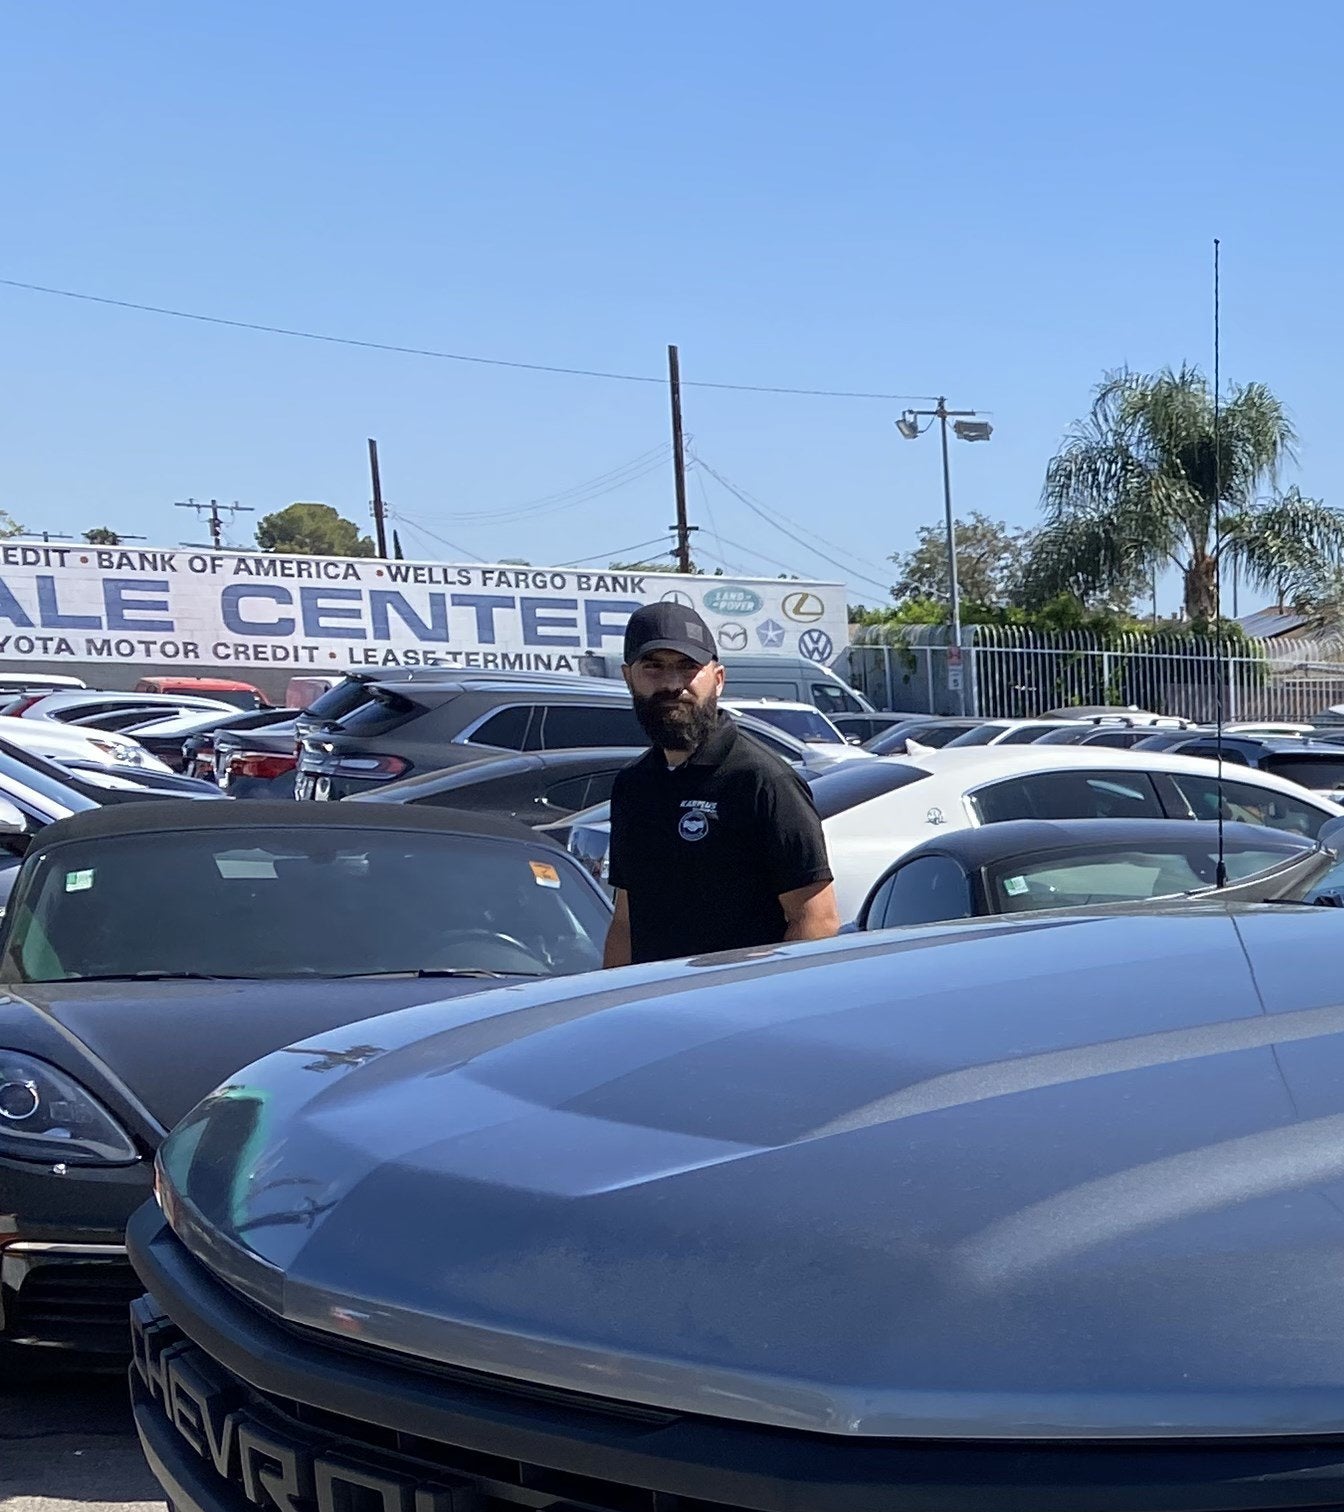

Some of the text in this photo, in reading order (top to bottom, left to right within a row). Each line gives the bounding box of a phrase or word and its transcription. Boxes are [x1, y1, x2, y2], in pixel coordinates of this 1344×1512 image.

[2, 546, 647, 594] EDIT BANK OF AMERICA WELLS FARGO BANK
[715, 592, 745, 601] LAND
[719, 600, 755, 611] ROVER
[221, 583, 645, 648] CENTER
[86, 637, 200, 660] MOTOR
[211, 641, 320, 663] CREDIT
[348, 647, 436, 667] LEASE
